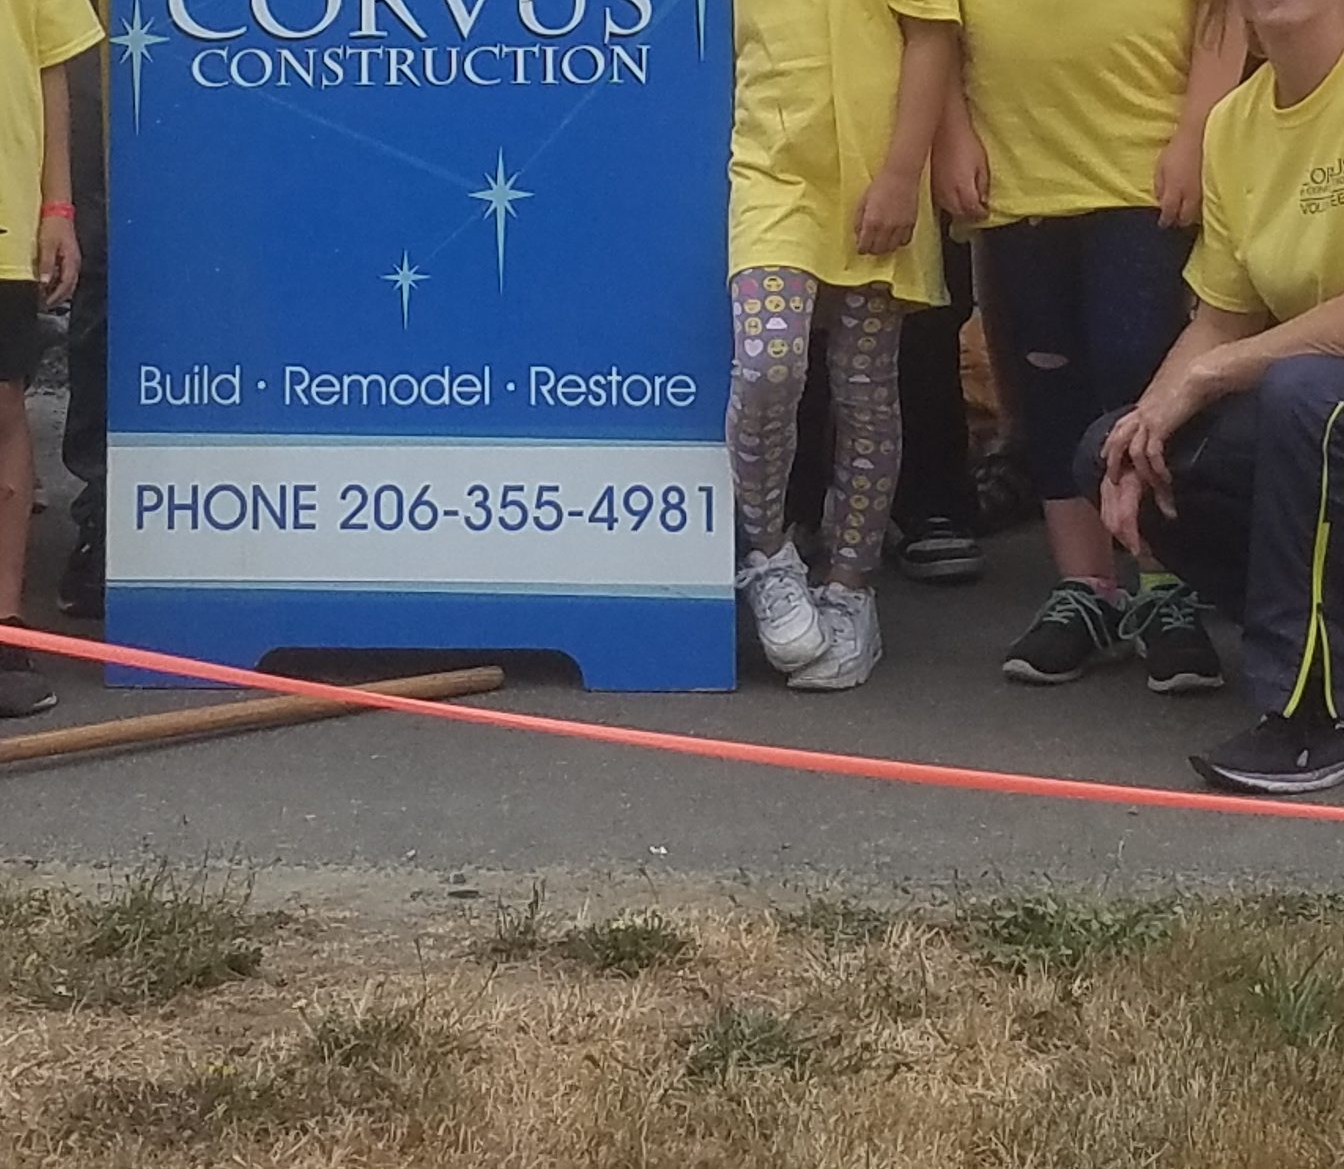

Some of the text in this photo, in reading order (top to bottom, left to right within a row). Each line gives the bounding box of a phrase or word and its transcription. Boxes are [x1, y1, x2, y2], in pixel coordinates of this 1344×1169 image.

[191, 43, 650, 90] CONSTRUCTION
[139, 365, 698, 407] Build Remodel Restore
[135, 483, 718, 534] PHONE 206-355-4981
